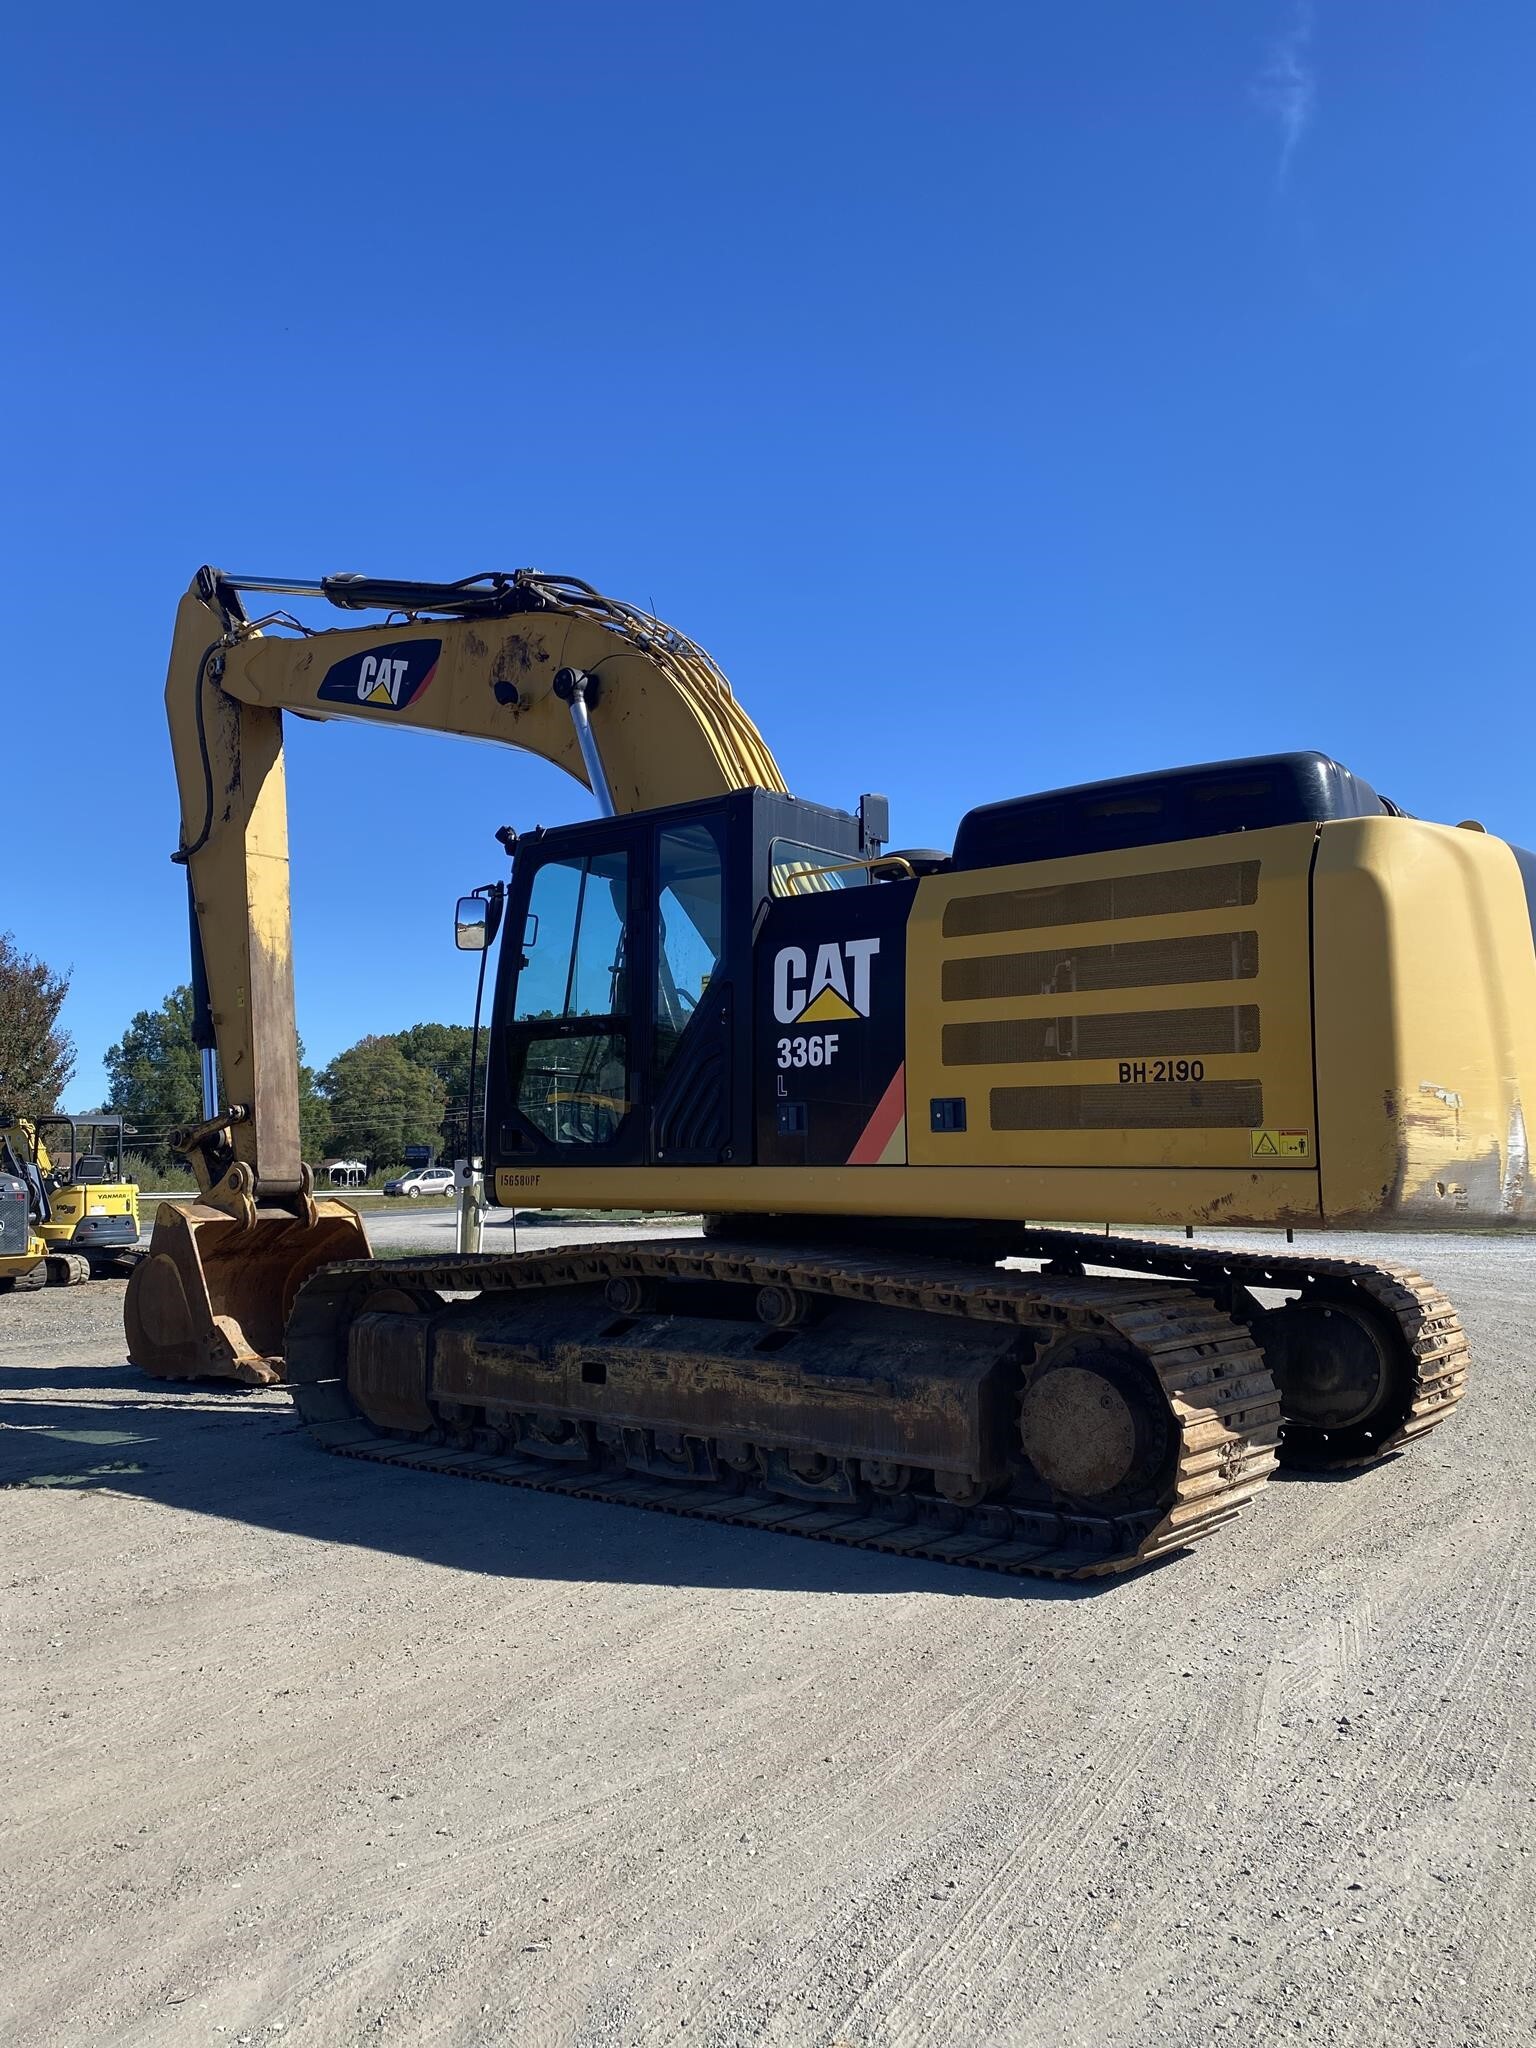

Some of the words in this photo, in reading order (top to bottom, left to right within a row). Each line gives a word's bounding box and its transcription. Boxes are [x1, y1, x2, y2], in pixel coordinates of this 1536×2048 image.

[357, 656, 408, 705] CAT
[774, 938, 880, 1024] CAT
[777, 1034, 839, 1069] 336F
[777, 1075, 788, 1097] L
[1118, 1060, 1204, 1083] BH-2190
